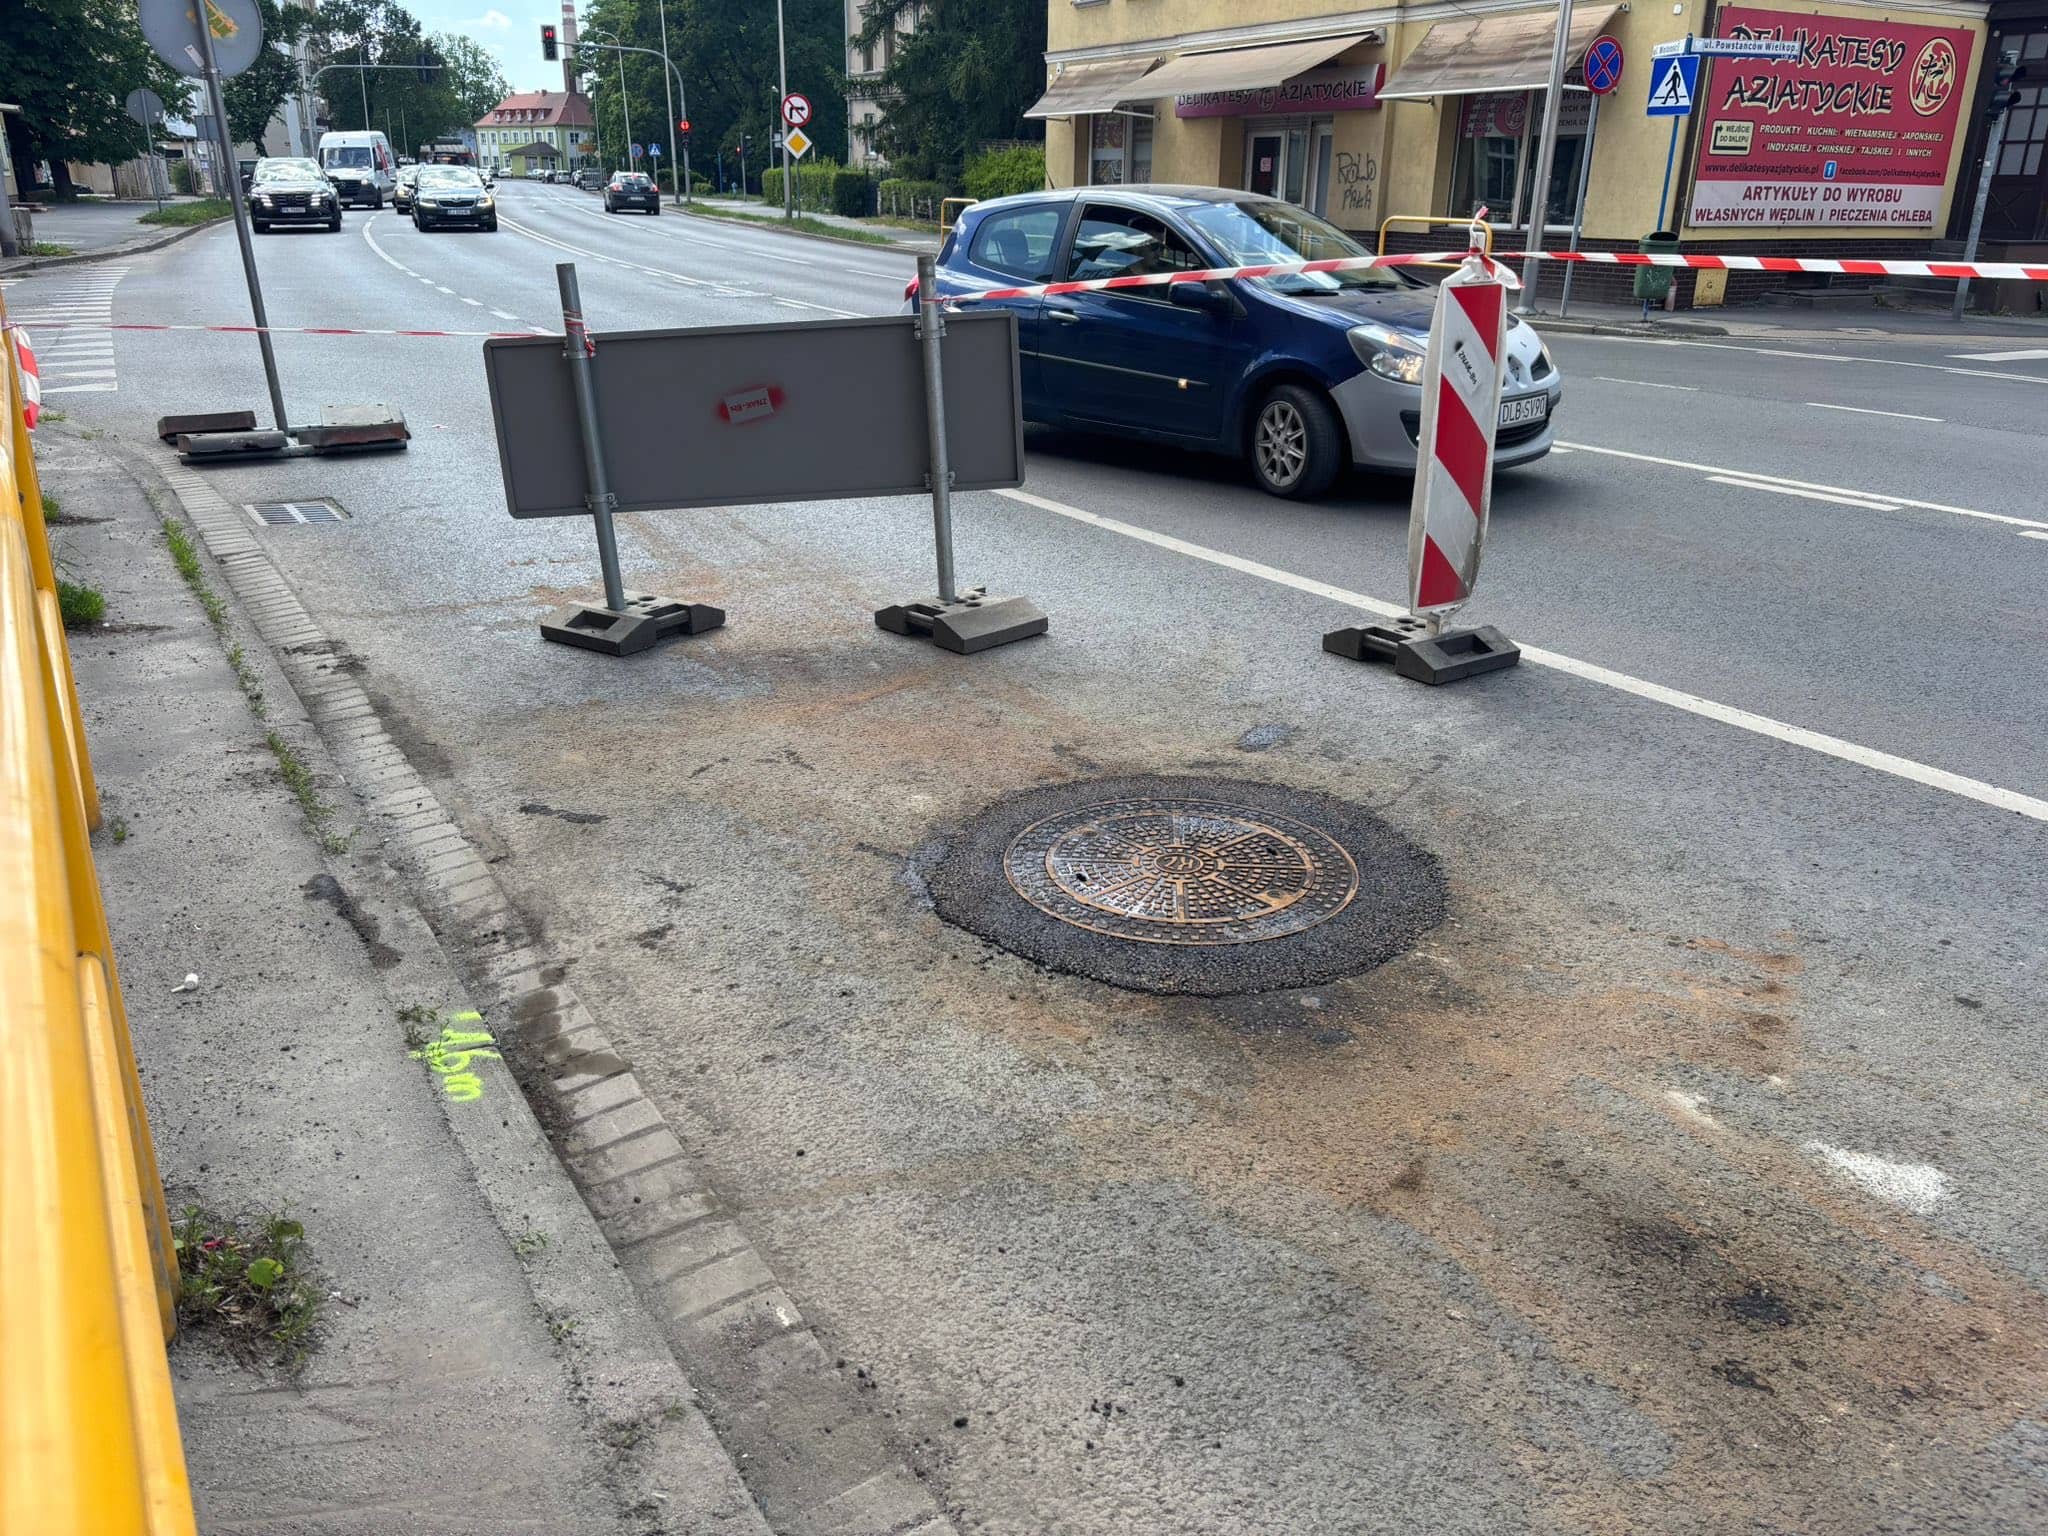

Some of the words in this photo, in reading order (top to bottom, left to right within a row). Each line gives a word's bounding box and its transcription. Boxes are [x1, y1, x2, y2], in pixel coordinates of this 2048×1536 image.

[1760, 125, 1801, 135] PRODUKTY
[1844, 129, 1897, 139] WIETNAMSKIEJ
[1766, 142, 1811, 153] INDYJSKIEJ
[1861, 146, 1893, 156] TAJSKIEJ
[1906, 148, 1932, 157] INNYCH
[1743, 186, 1818, 201] ARTYKUŁY
[1823, 187, 1841, 202] DO
[1847, 187, 1903, 203] WYROBU
[1695, 208, 1765, 222] WŁASNYCH
[1769, 208, 1815, 225] WĘDLIN
[1829, 209, 1887, 222] PIECZENIA
[1891, 210, 1933, 223] CHLEBA
